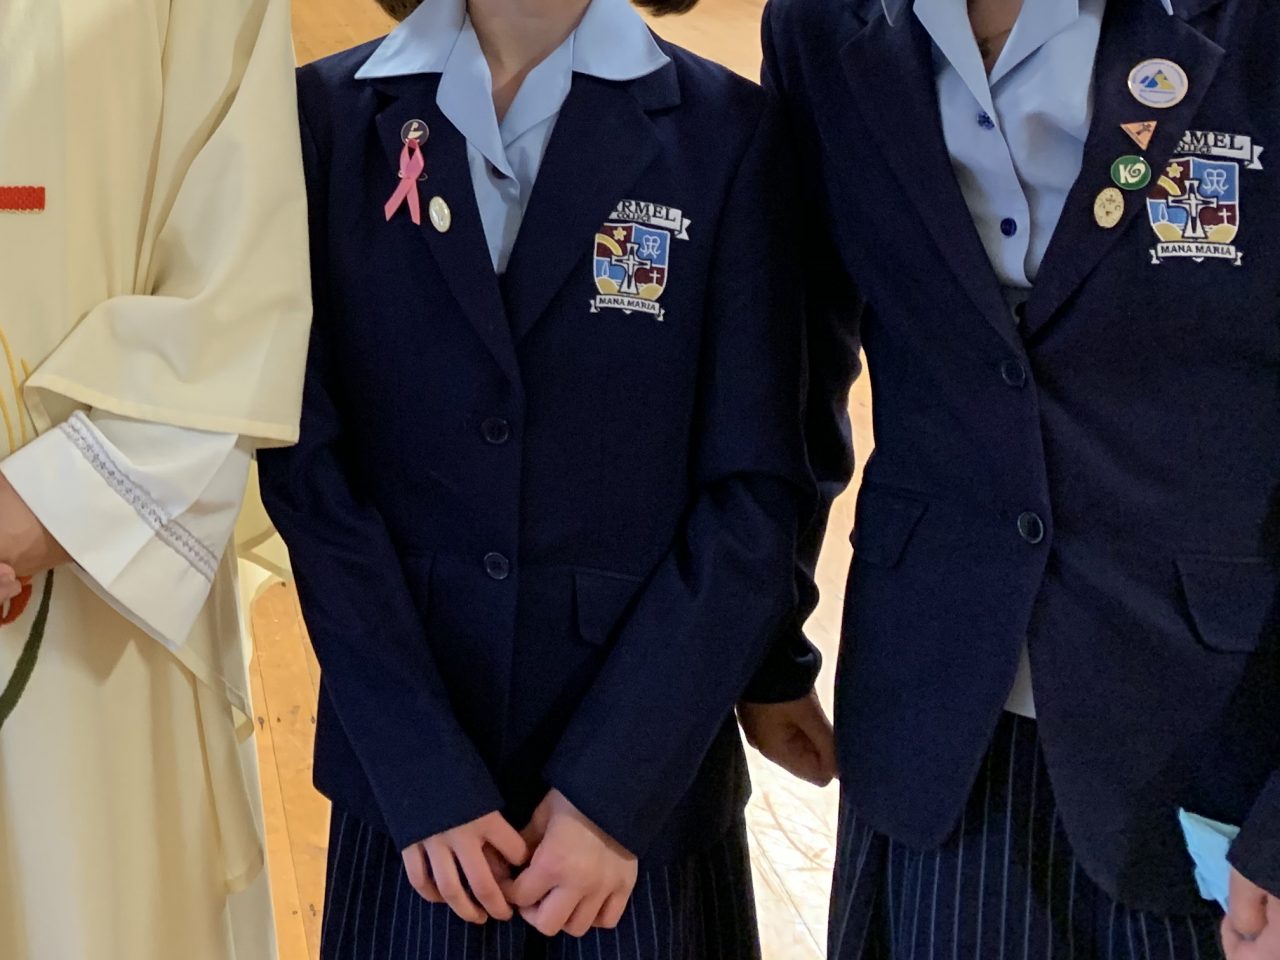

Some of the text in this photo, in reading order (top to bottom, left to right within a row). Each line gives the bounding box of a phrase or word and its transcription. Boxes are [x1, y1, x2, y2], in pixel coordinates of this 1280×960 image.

[619, 199, 677, 223] RMEL
[1161, 243, 1233, 257] MANA MARIA
[598, 296, 657, 312] MANA MARIA
